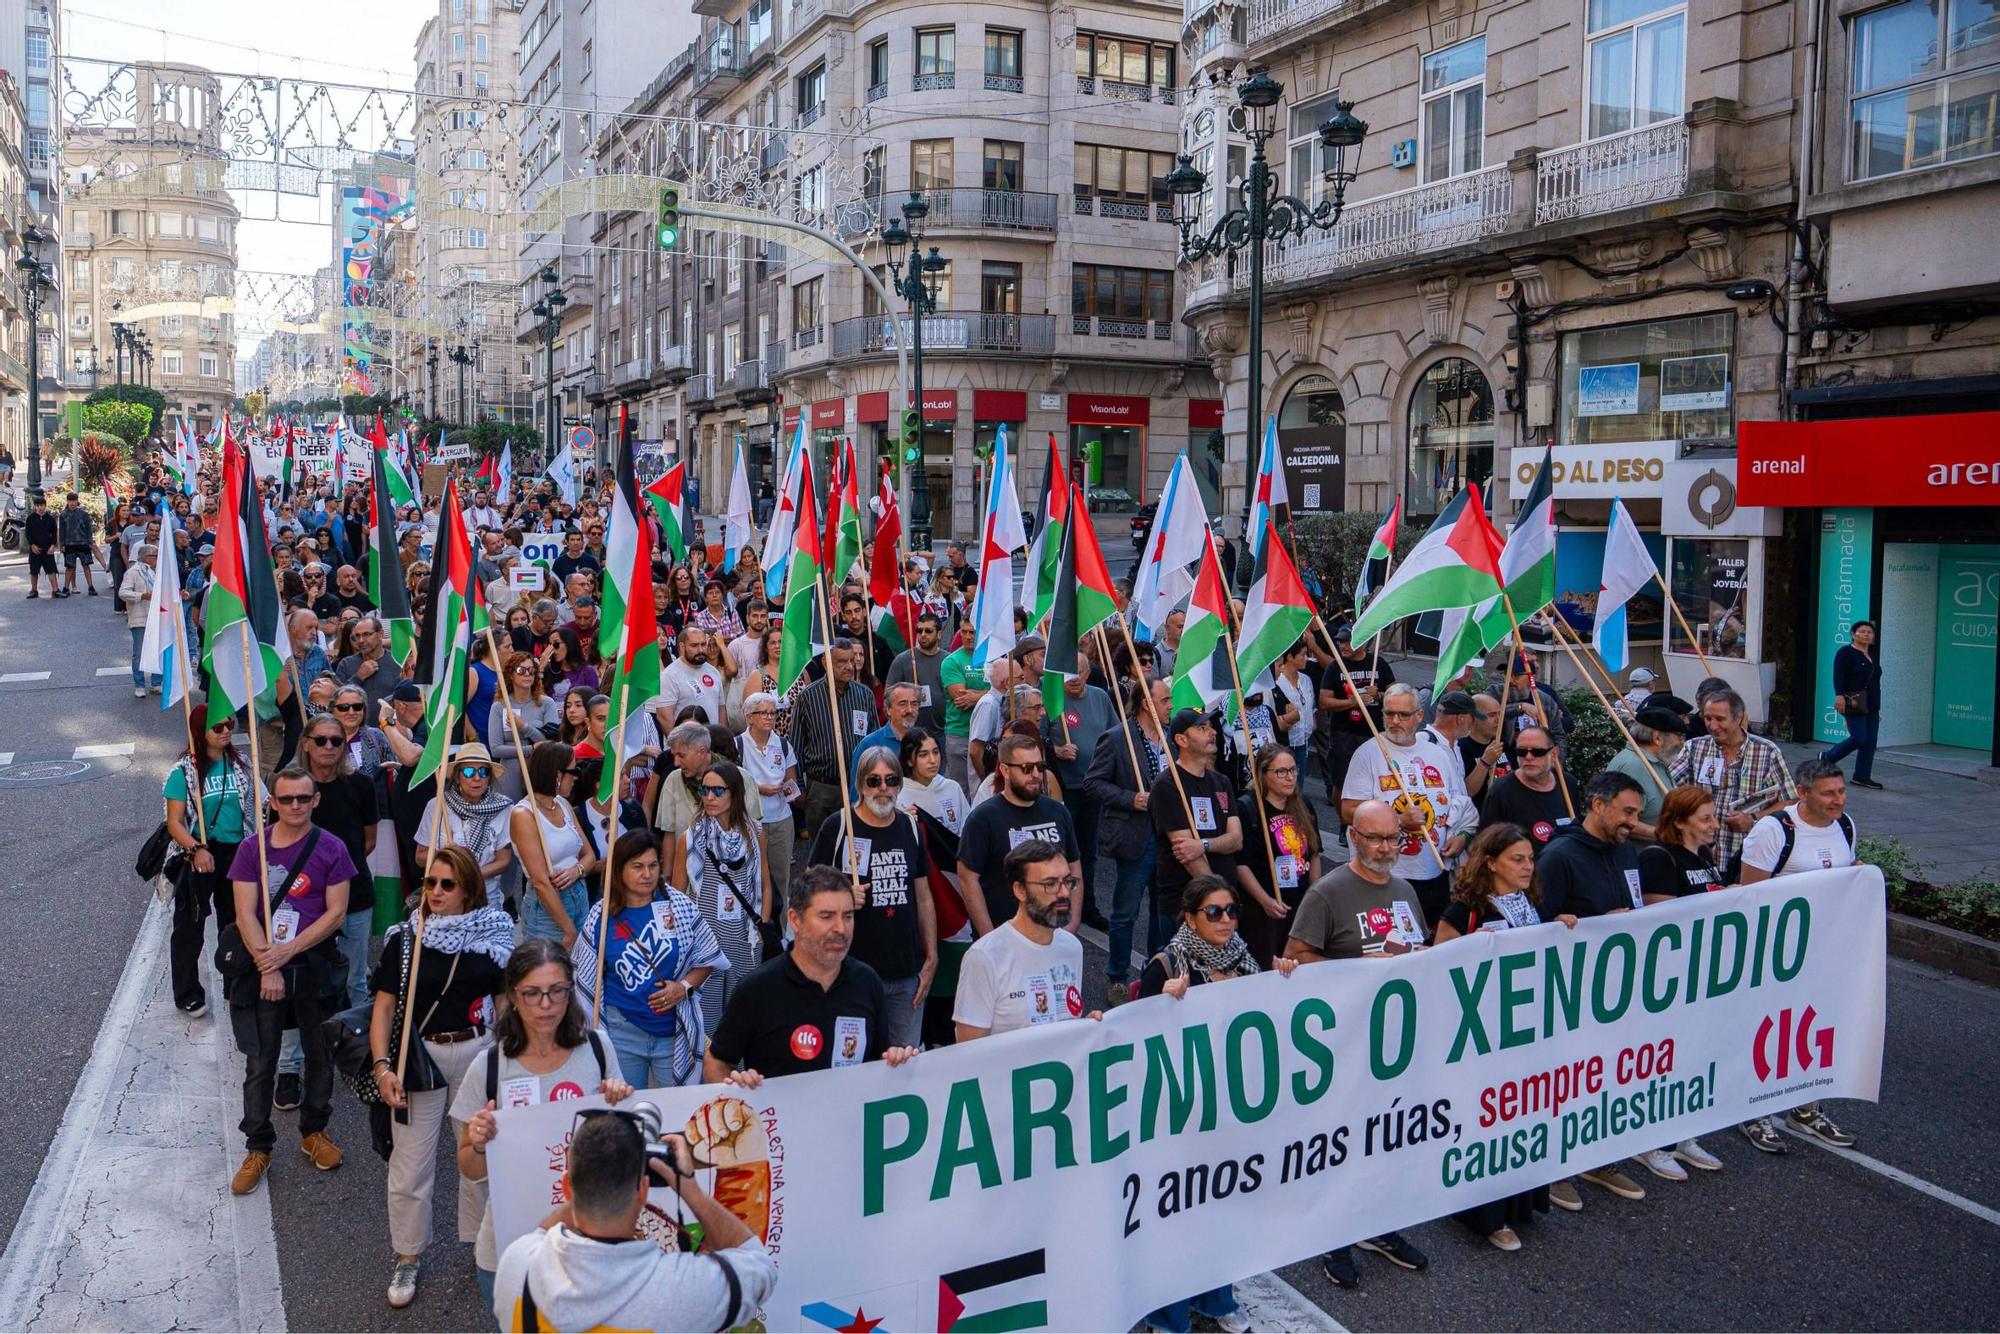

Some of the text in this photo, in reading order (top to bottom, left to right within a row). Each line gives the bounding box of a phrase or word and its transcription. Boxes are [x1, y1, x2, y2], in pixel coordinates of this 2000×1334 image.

[908, 400, 952, 409] VonLab!
[1090, 404, 1129, 414] VisionLab!
[1286, 454, 1340, 467] CALZEDONIA
[1752, 455, 1806, 474] arenal
[1517, 458, 1664, 485] OO AL PESO
[523, 543, 559, 560] on
[1717, 558, 1745, 567] TALLER
[1726, 570, 1736, 578] DE
[1834, 516, 1856, 645] Parafarmacia
[1823, 727, 1850, 738] arena
[870, 851, 907, 866] ANTI
[871, 864, 908, 880] IMPE
[872, 878, 908, 893] RIAL
[872, 892, 908, 907] ISTA
[1009, 990, 1026, 999] END
[1752, 1003, 1835, 1083] CIG
[863, 895, 1812, 1217] PAREMOS O XENOCIDIO
[1441, 1061, 1717, 1189] causa palestina!
[1122, 1037, 1675, 1239] 2 anos nas rúas, sempre coa
